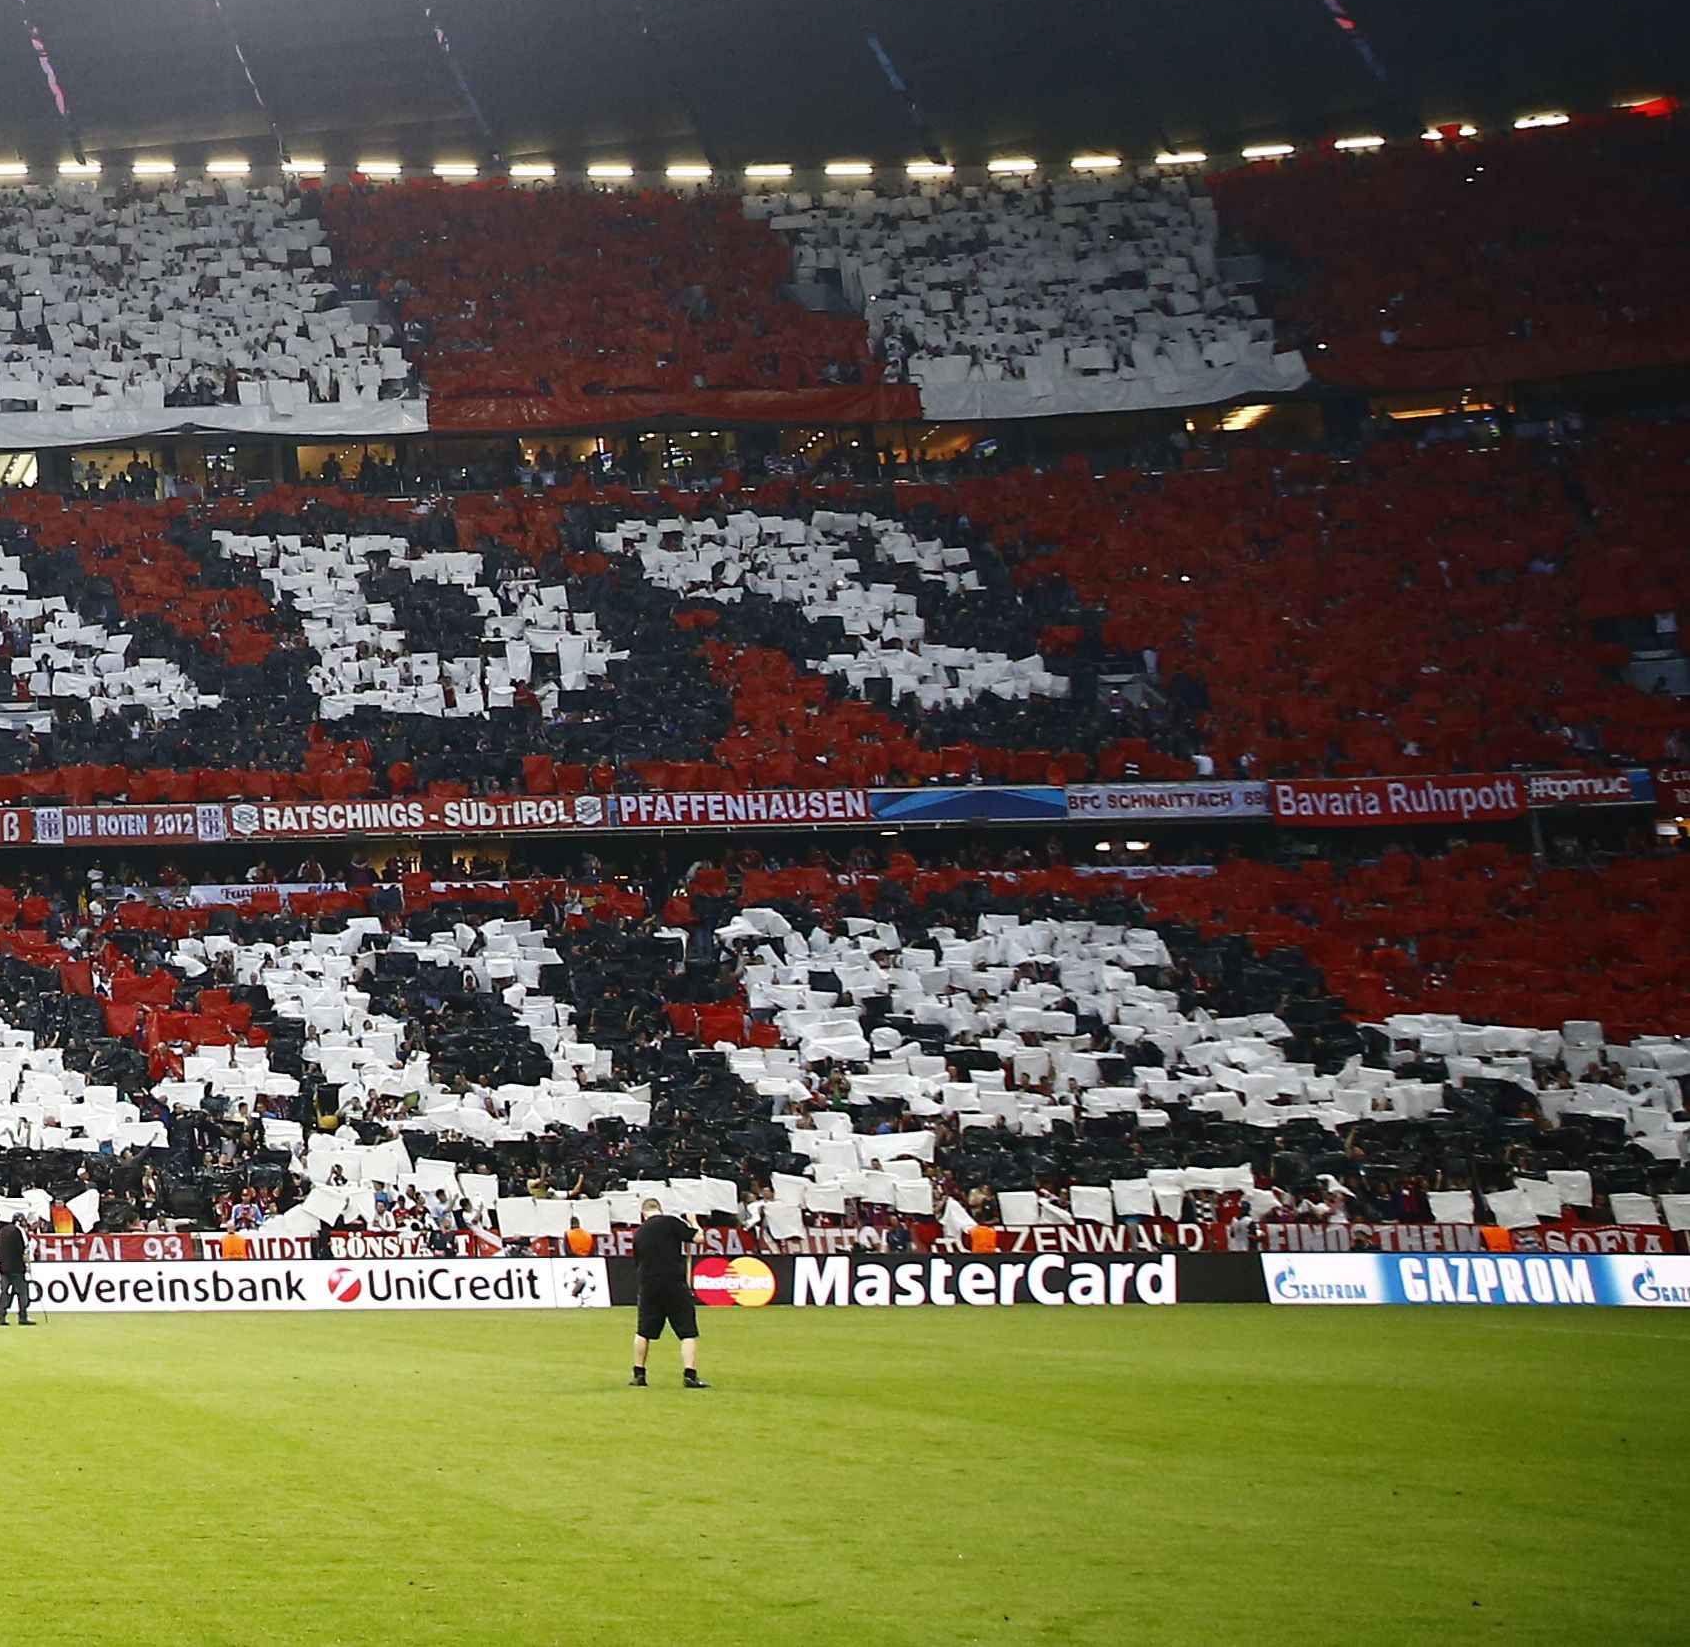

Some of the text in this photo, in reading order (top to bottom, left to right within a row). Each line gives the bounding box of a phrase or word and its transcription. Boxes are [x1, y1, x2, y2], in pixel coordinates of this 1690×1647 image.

[621, 791, 867, 823] PFAFFENHAUSEN
[1067, 794, 1102, 810] BFC
[1275, 779, 1517, 819] Bavaria Ruhrpott
[67, 812, 194, 837] DIE ROTEN 2012
[263, 802, 425, 831] RATSCHINGS
[444, 797, 575, 827] SÜDTIROL
[142, 1236, 184, 1261] 93
[330, 1231, 470, 1259] BÖNSTAT
[1545, 1229, 1665, 1253] SOFIA
[367, 1267, 542, 1303] UniCredit
[693, 1274, 774, 1291] MasterCard
[792, 1253, 1177, 1307] MasterCard
[1300, 1284, 1368, 1299] GAZPROM
[1398, 1257, 1597, 1303] GAZPROM
